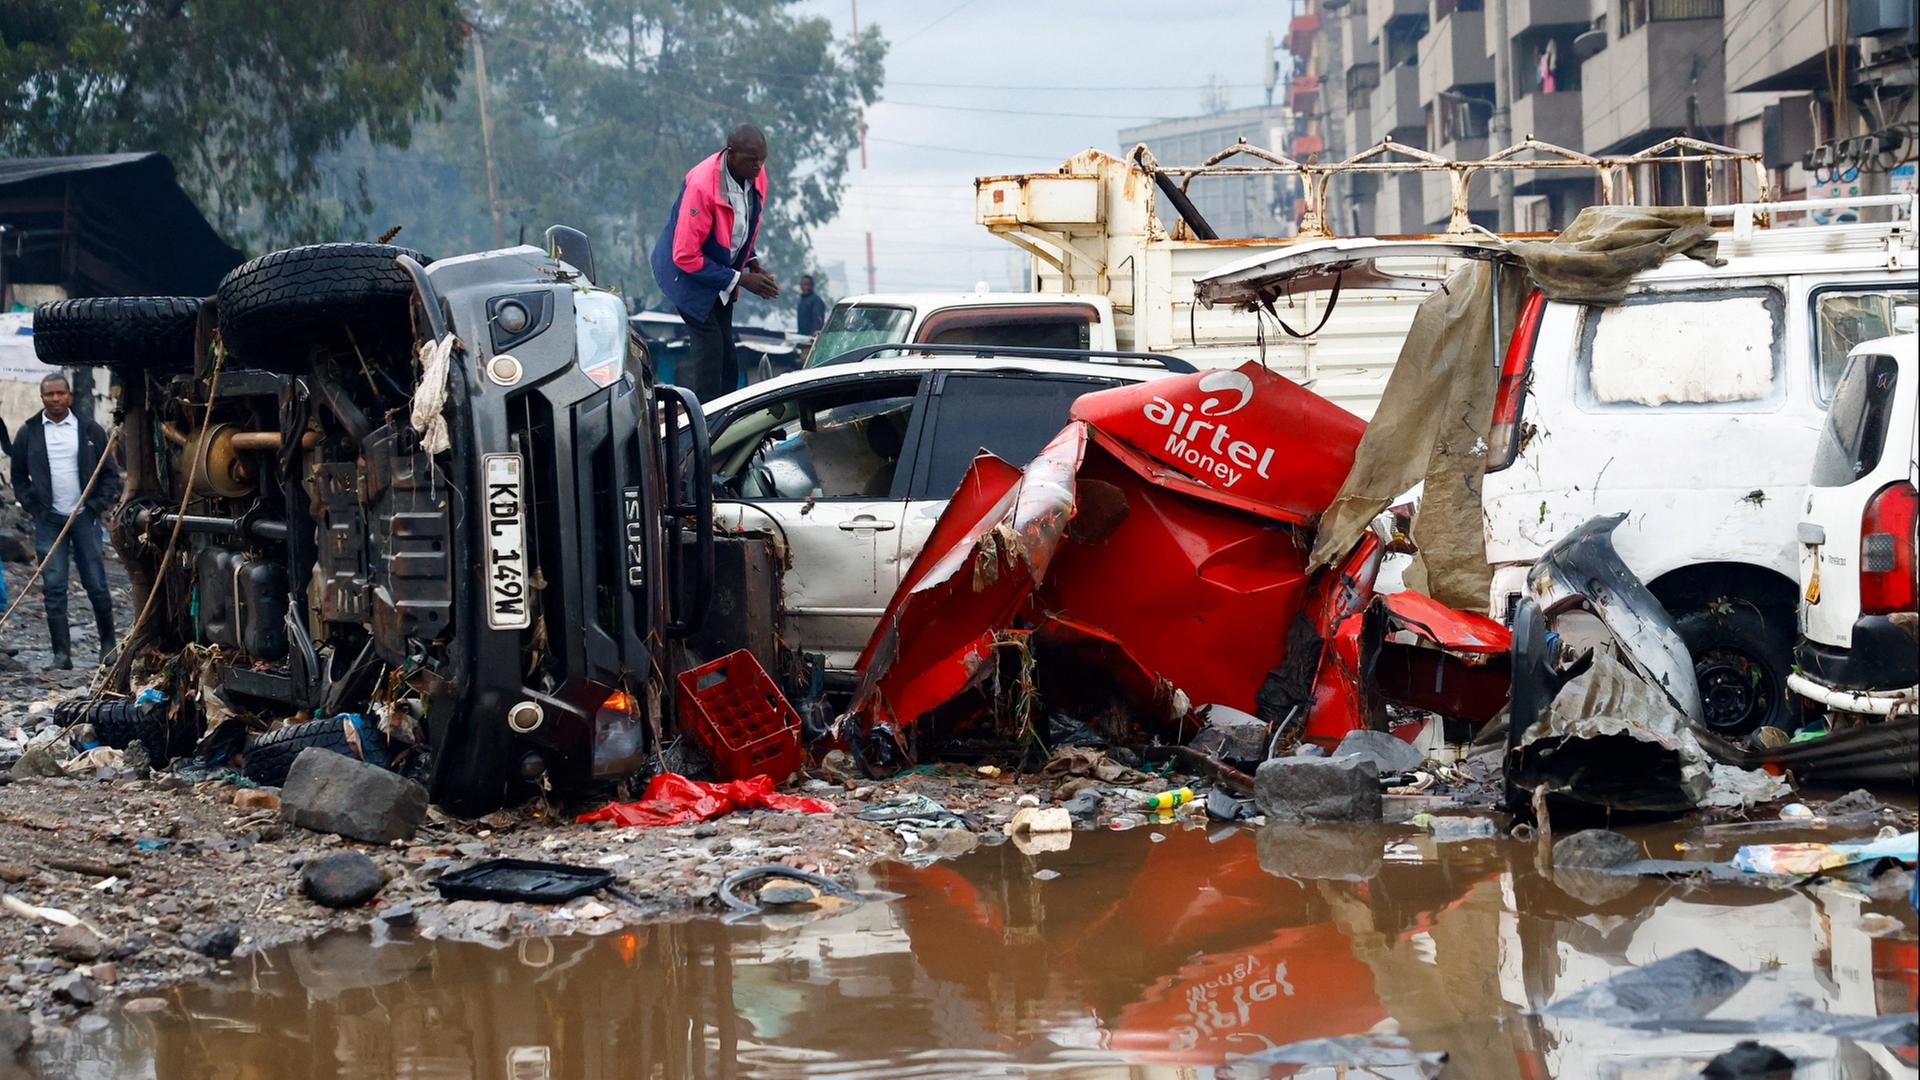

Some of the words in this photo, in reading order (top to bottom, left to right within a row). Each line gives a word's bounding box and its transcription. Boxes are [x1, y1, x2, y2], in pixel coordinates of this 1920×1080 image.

[1143, 395, 1275, 480] airtel
[1164, 433, 1242, 488] Money
[489, 483, 519, 537] KDL
[624, 490, 643, 586] ISUZU
[492, 549, 524, 615] 149W
